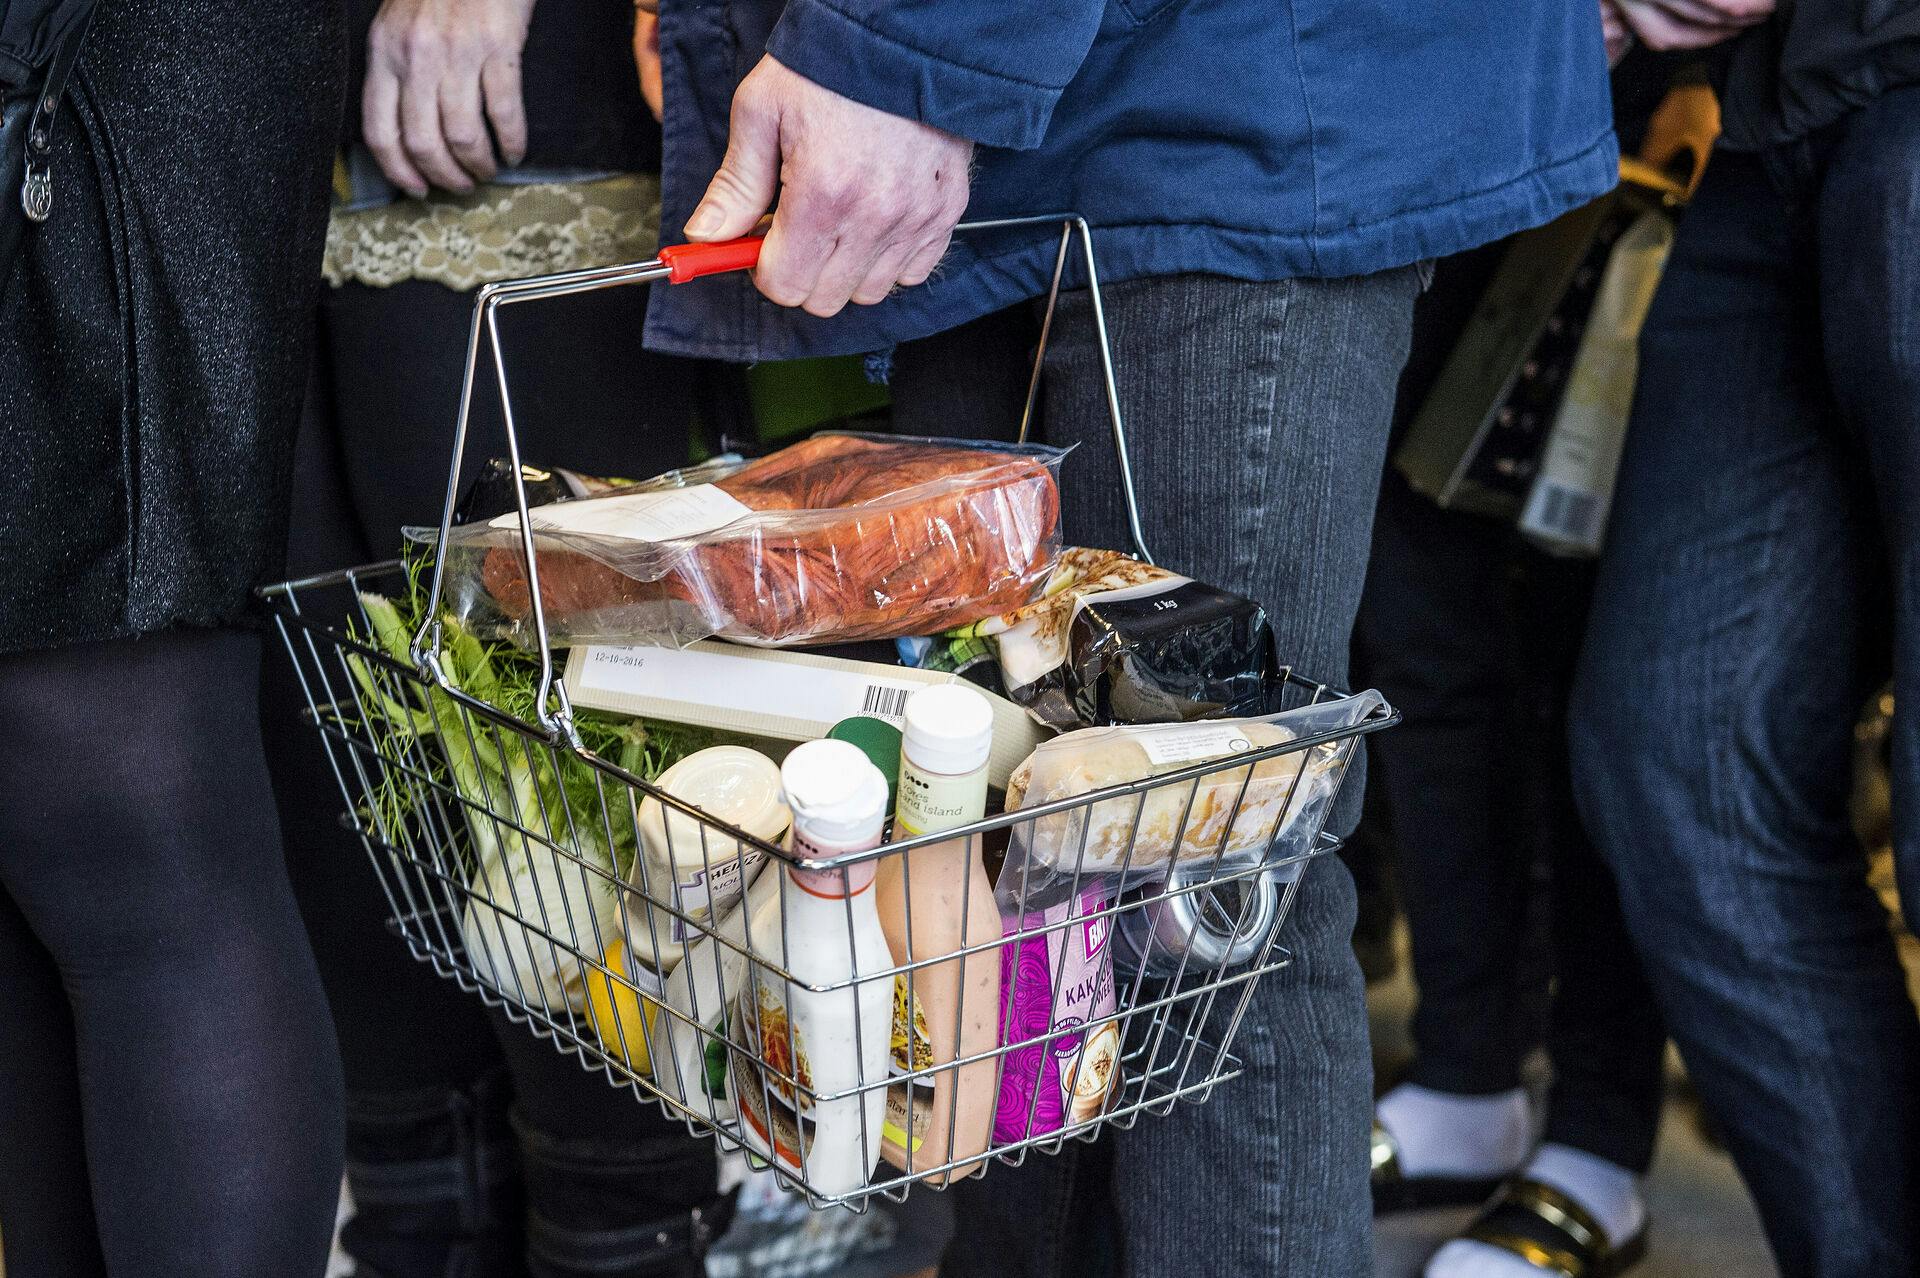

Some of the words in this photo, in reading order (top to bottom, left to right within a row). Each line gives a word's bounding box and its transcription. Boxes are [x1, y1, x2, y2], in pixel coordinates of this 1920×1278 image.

[1160, 600, 1178, 609] kg
[595, 652, 644, 667] 12-10-2016
[923, 802, 963, 817] island
